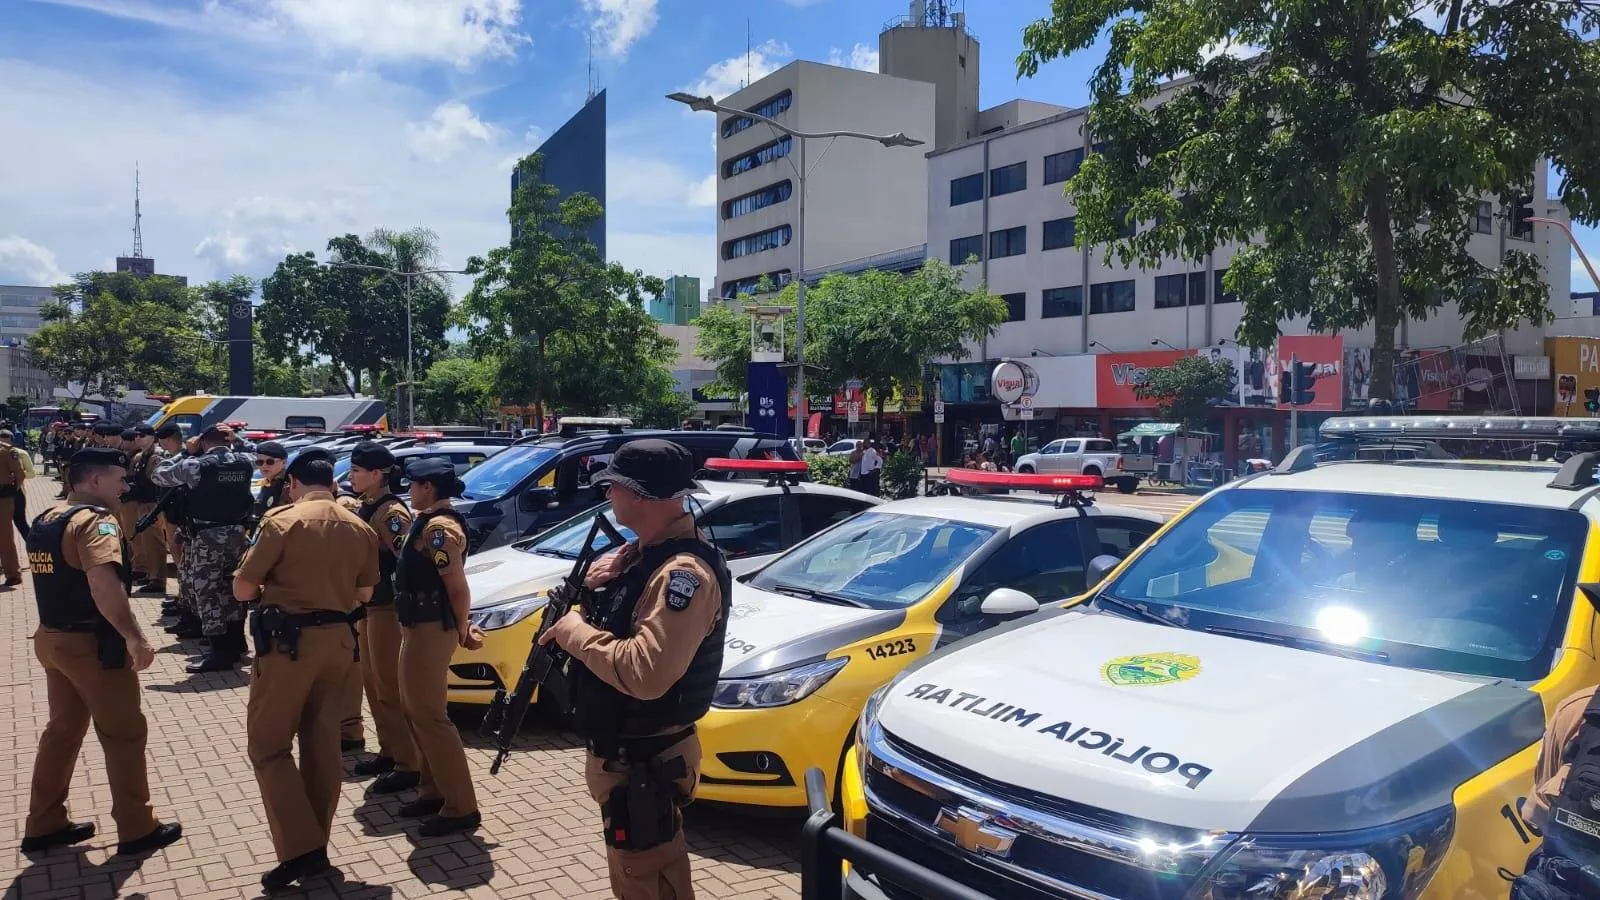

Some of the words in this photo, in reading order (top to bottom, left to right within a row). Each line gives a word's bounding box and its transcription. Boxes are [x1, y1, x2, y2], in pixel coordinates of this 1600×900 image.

[1280, 360, 1340, 376] Vual
[998, 378, 1023, 388] Visual
[218, 474, 245, 482] CHOQUE
[30, 563, 54, 574] ILITAR
[865, 638, 916, 661] 14223
